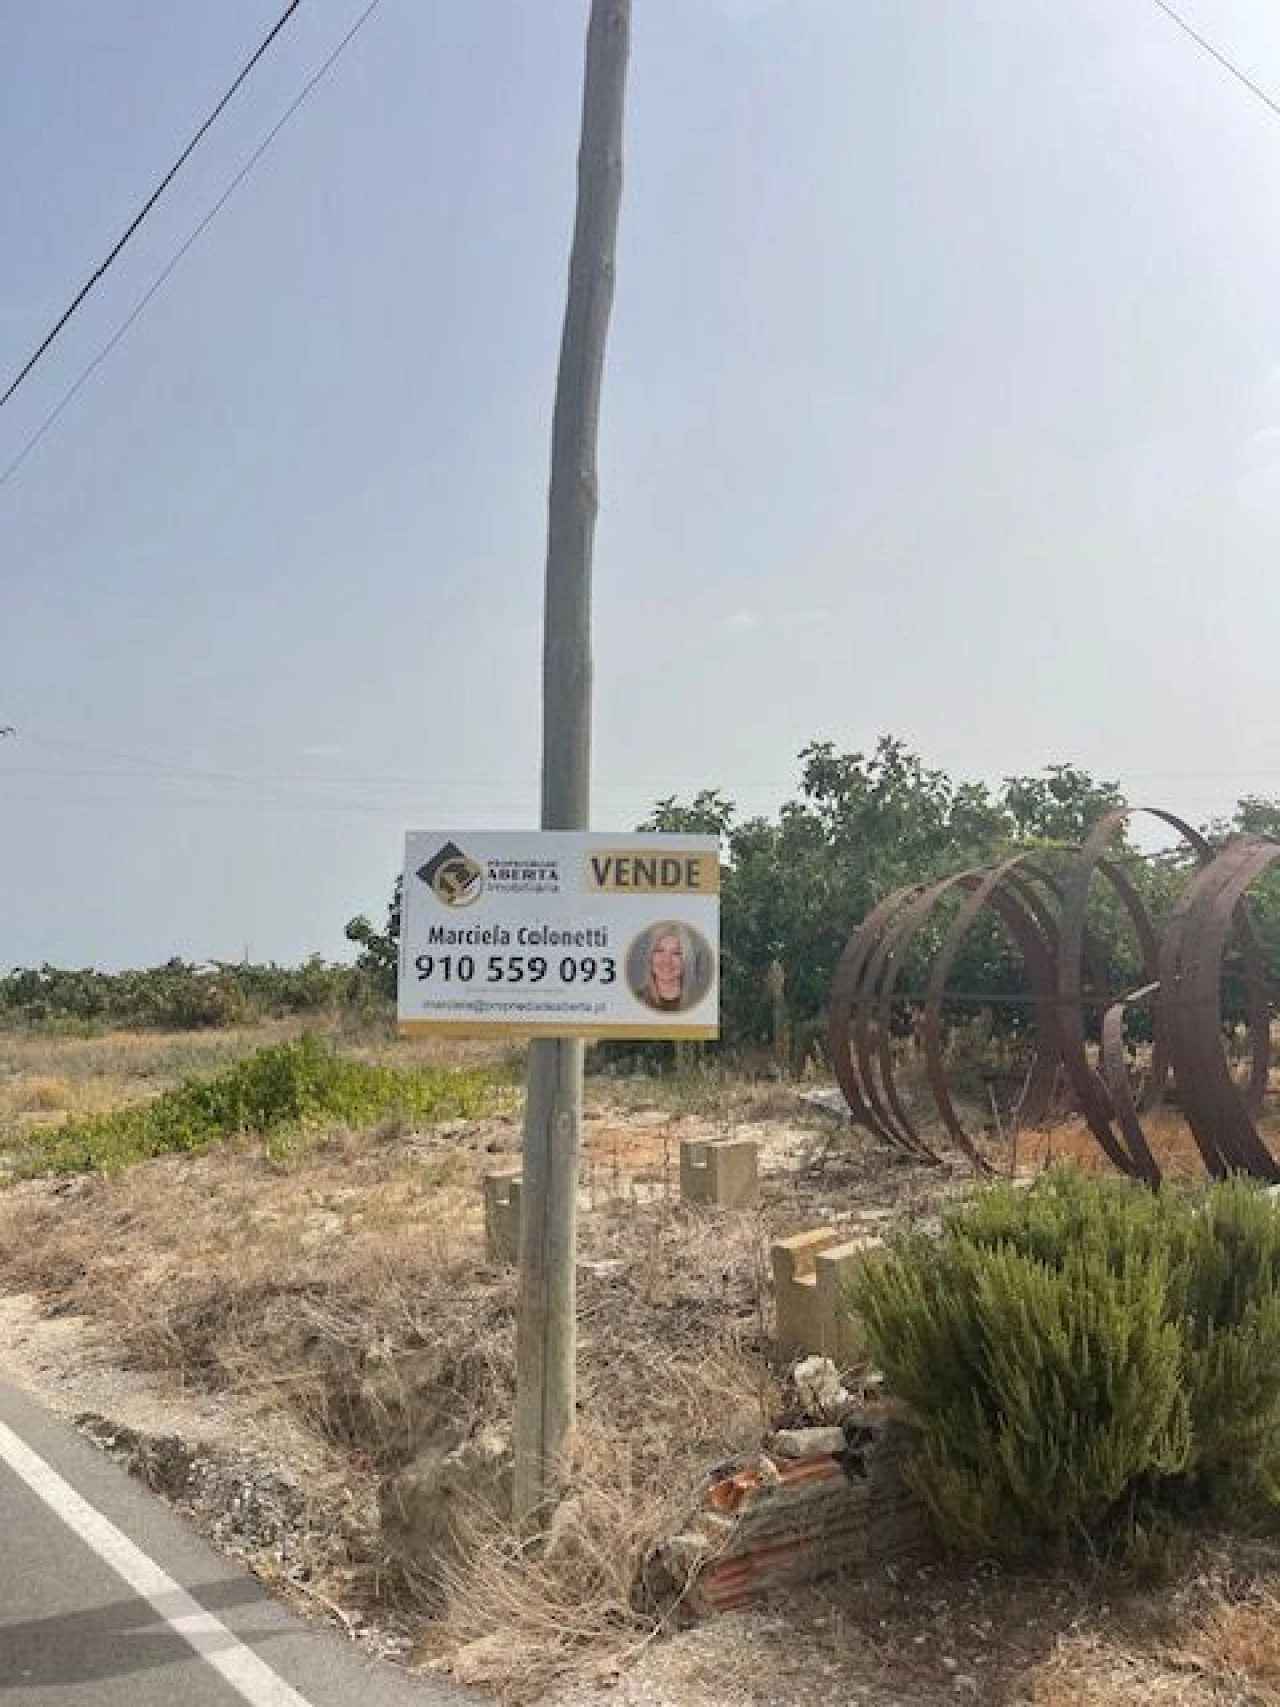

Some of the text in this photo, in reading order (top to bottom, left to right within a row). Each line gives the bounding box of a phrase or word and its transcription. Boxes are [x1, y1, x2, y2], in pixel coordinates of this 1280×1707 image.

[487, 869, 558, 881] ABERTA
[591, 857, 700, 887] VENDE
[428, 926, 608, 948] Marciela Colonetti
[415, 955, 617, 984] 910 559 093
